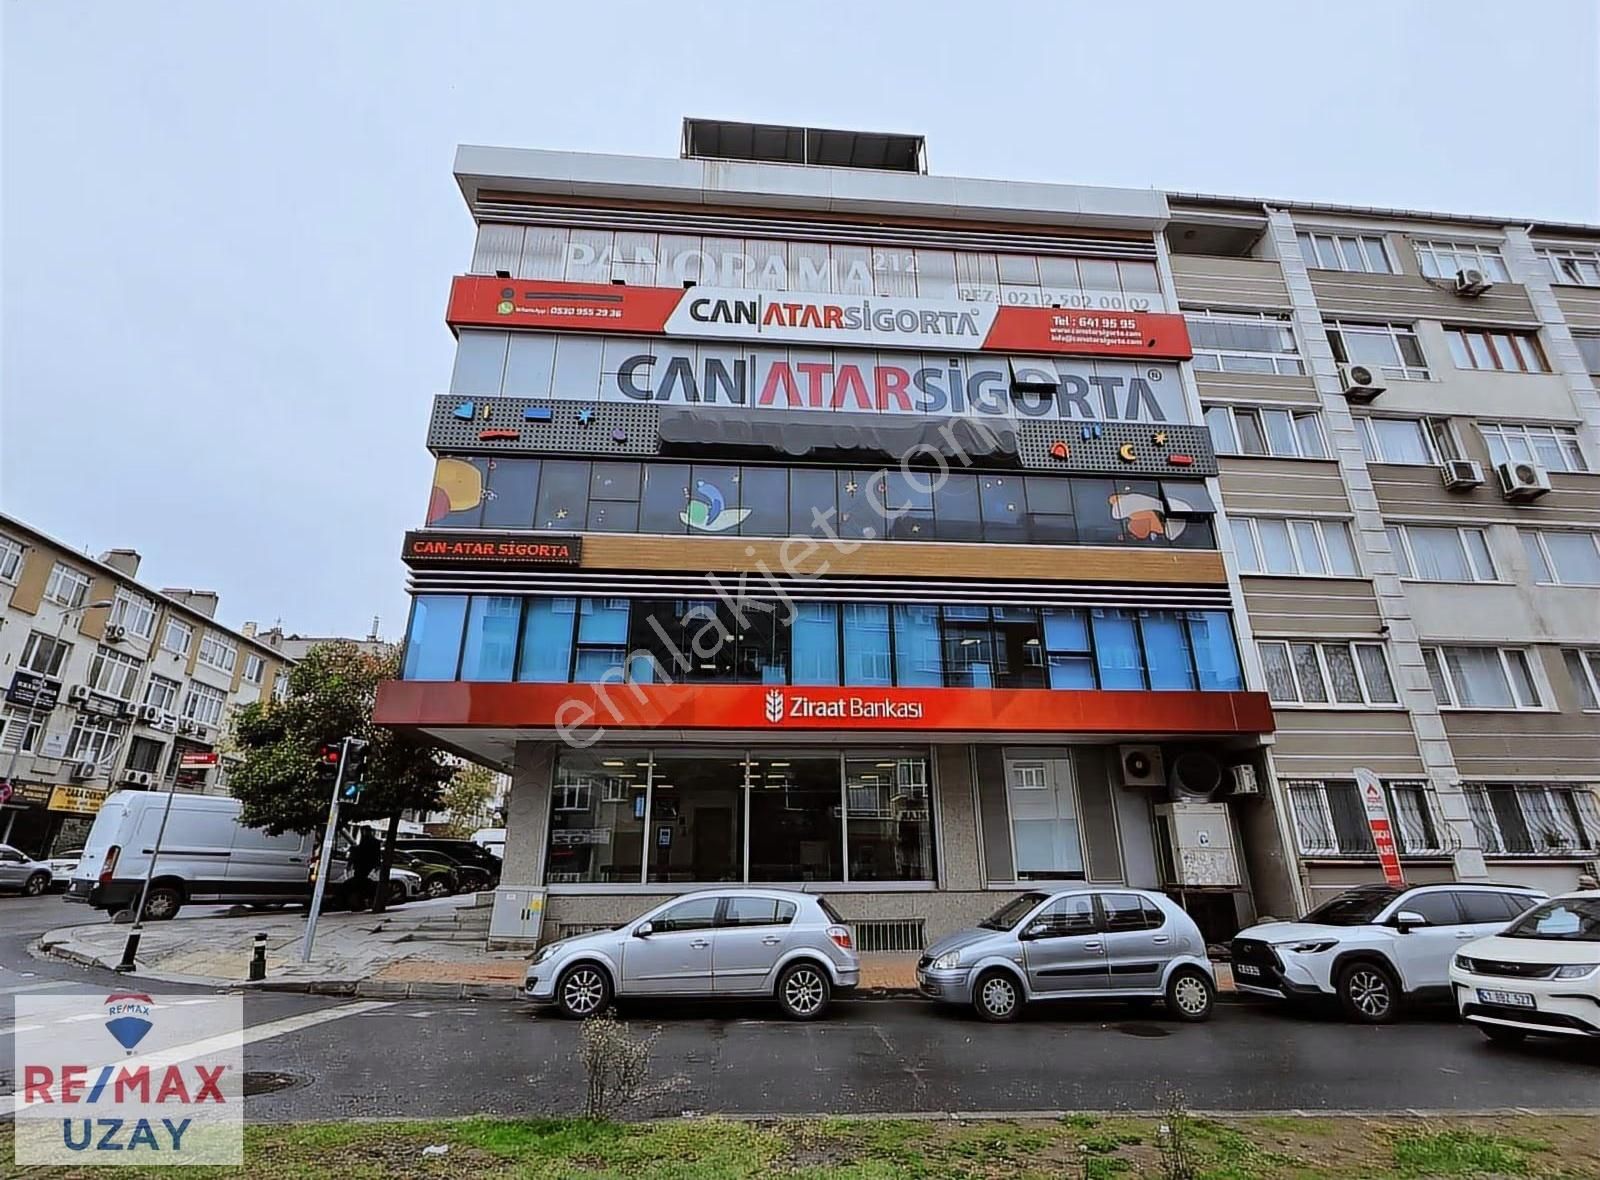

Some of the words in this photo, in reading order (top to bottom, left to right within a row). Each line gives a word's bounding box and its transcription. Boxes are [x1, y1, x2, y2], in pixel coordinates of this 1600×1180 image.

[1053, 316, 1069, 326] Tel
[1079, 317, 1099, 328] 641
[789, 697, 846, 717] Ziraat
[850, 698, 923, 719] Bankası
